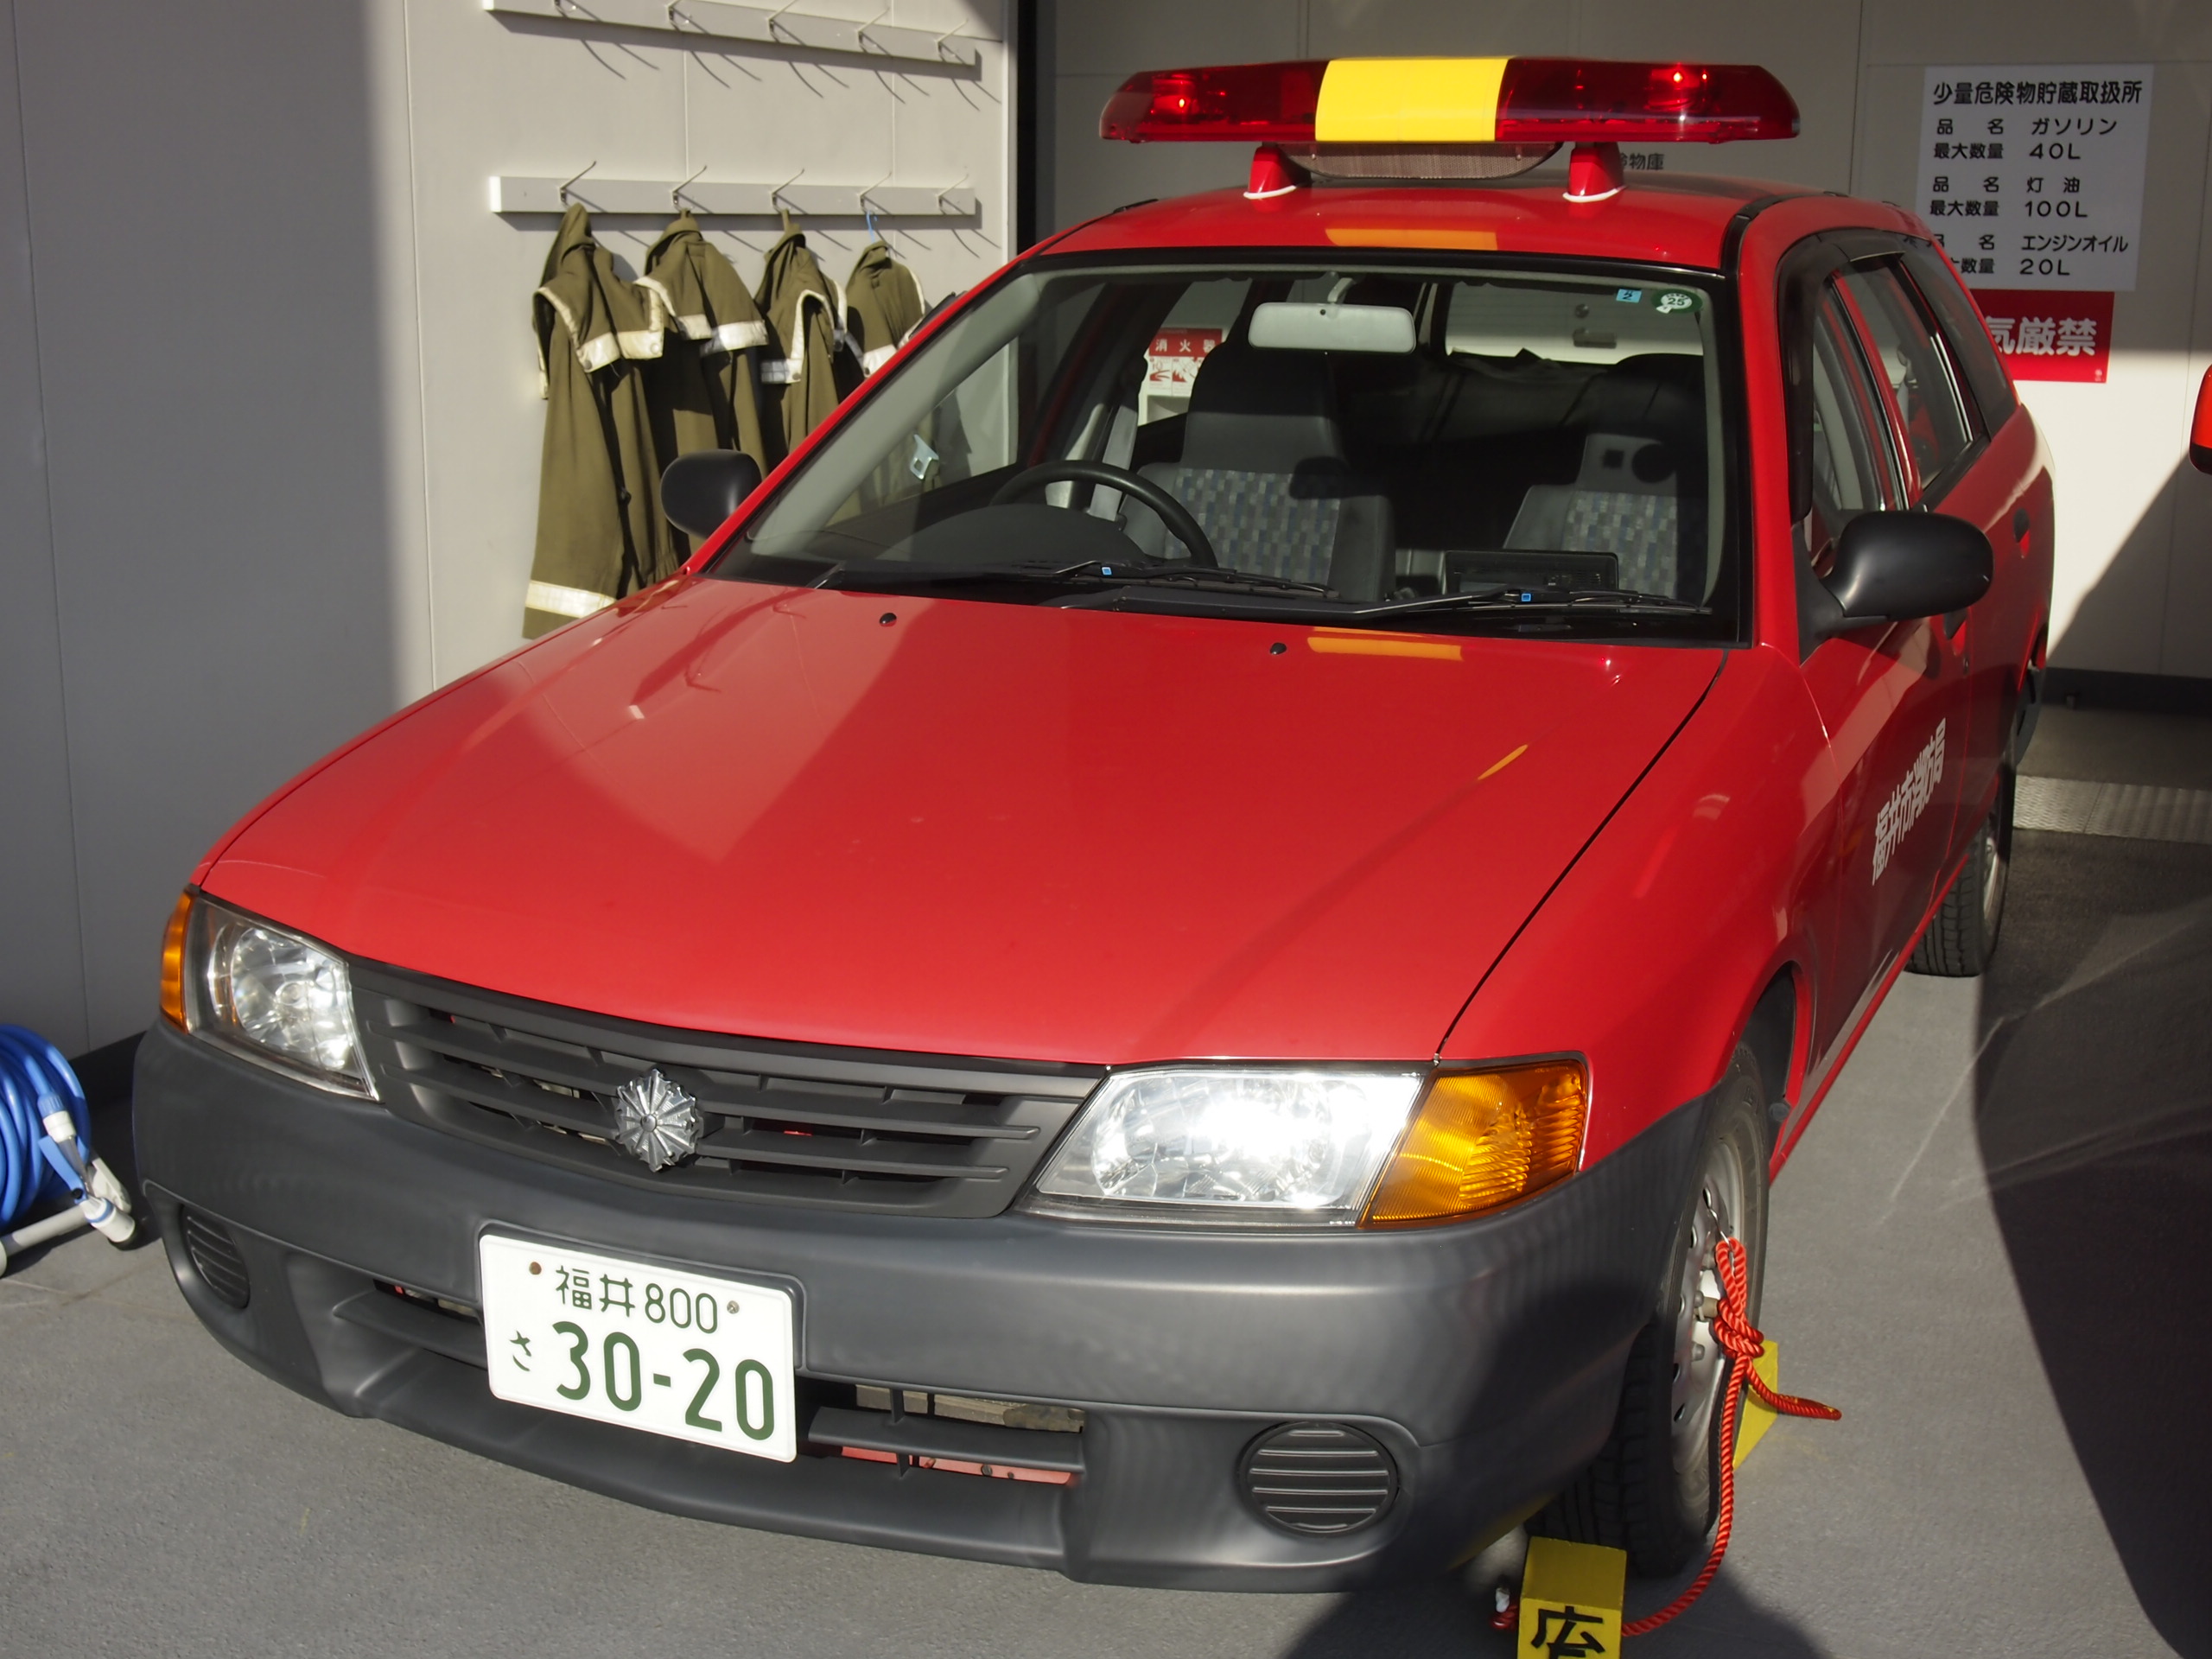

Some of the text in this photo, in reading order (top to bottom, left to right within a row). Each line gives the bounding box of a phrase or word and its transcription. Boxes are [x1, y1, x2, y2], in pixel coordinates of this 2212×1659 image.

[1933, 80, 2143, 105] 少量危険物貯蔵取扱所
[2031, 118, 2118, 137] ガソリン
[1933, 143, 2081, 160] 最大数量 40L
[1929, 200, 2088, 218] 最大数量 100L
[2021, 235, 2128, 253] エンジンオイル
[1950, 257, 2070, 276] 数量 20L
[1667, 297, 1686, 307] 25
[1872, 717, 1946, 887] 福井市消防局
[509, 1320, 775, 1441] さ 30-20
[1530, 1605, 1606, 1659] 広
